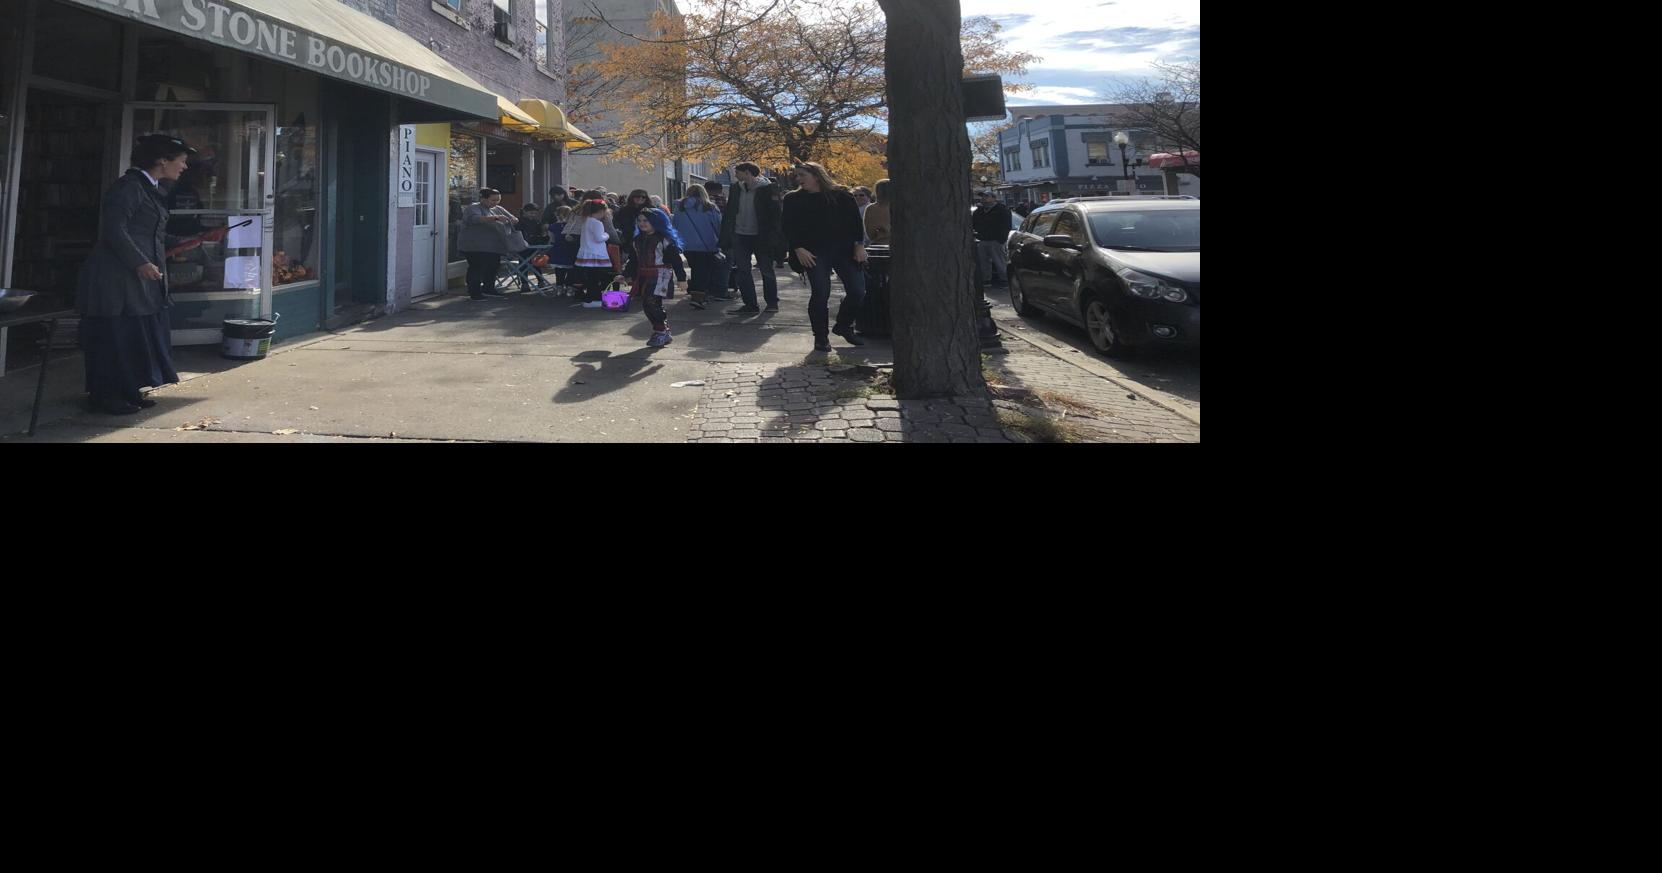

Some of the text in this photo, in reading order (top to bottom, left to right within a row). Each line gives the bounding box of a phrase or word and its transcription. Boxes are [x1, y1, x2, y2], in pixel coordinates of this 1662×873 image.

[181, 0, 431, 97] STONE BOOKSHOP
[401, 128, 412, 192] PIANO
